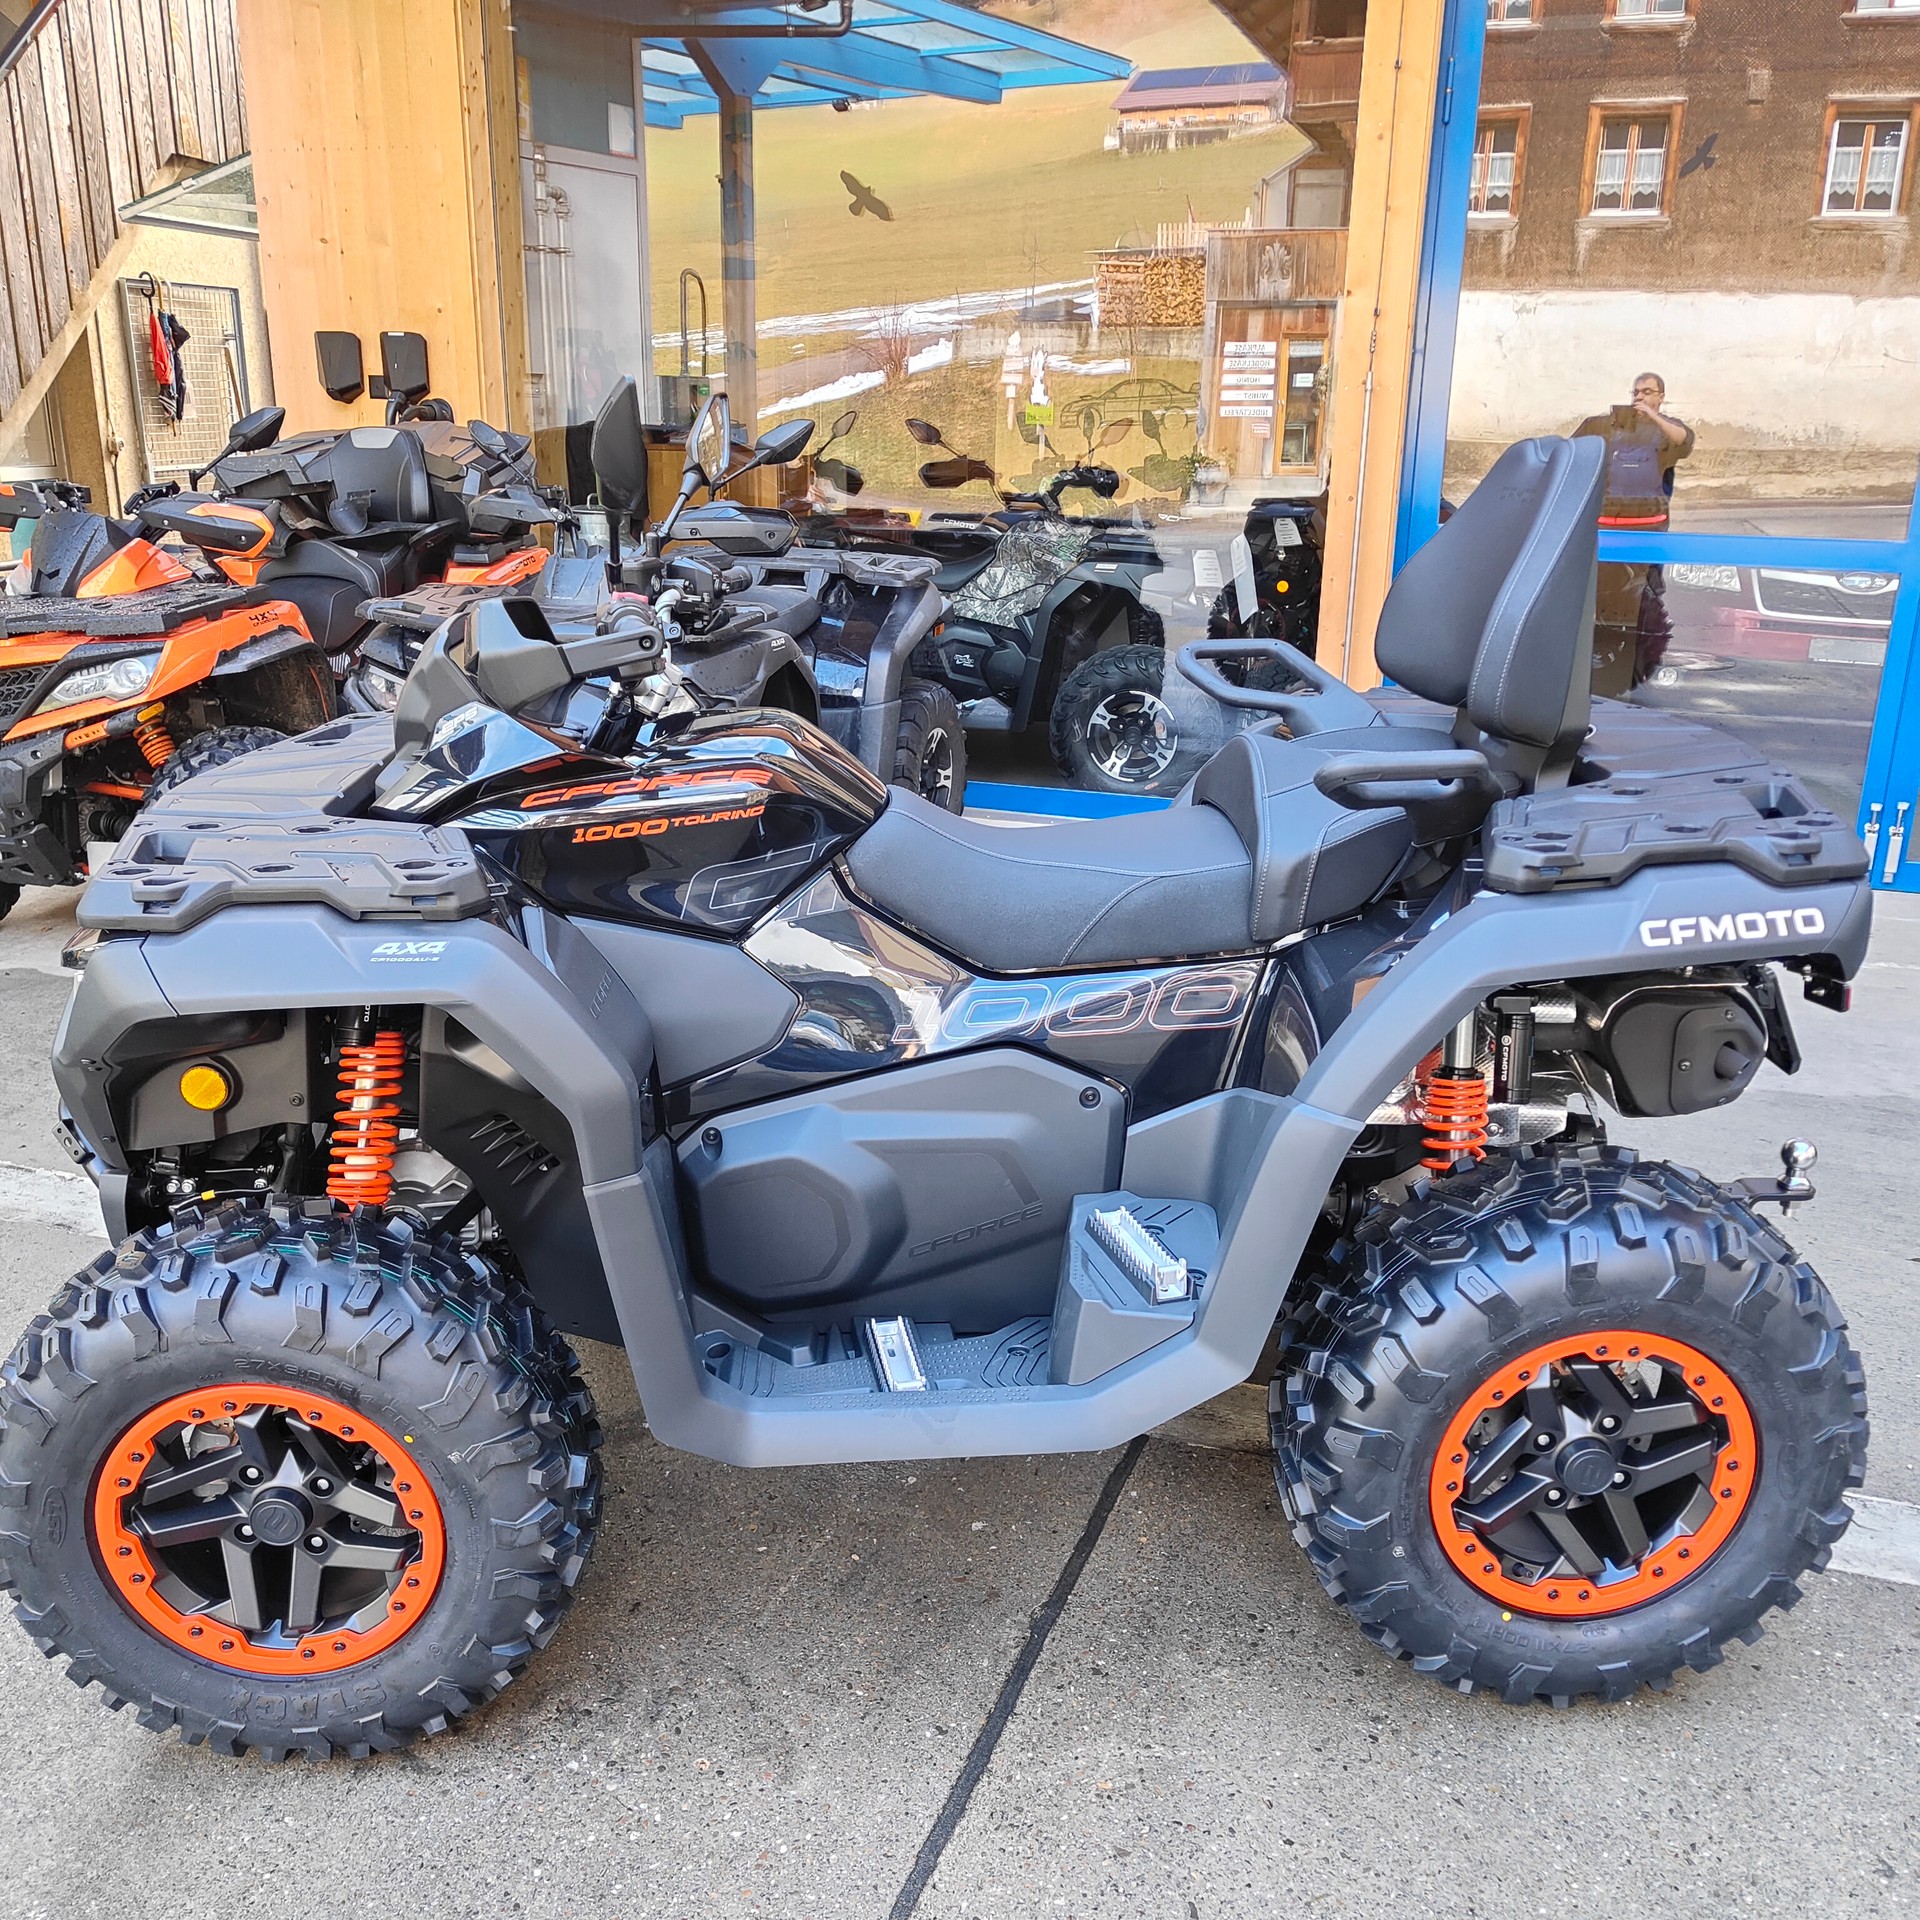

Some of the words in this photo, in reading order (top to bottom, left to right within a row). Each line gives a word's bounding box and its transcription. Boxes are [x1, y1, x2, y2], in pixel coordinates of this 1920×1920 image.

[441, 706, 479, 735] EPS
[519, 768, 774, 809] CFORCE
[571, 818, 669, 844] 1000
[673, 804, 766, 828] TOURING
[1638, 907, 1826, 947] CFMOTO
[372, 940, 448, 955] 4X4
[891, 970, 1257, 1045] 1000
[1501, 1046, 1510, 1082] CFMOTO
[908, 1199, 1044, 1259] CFORCE
